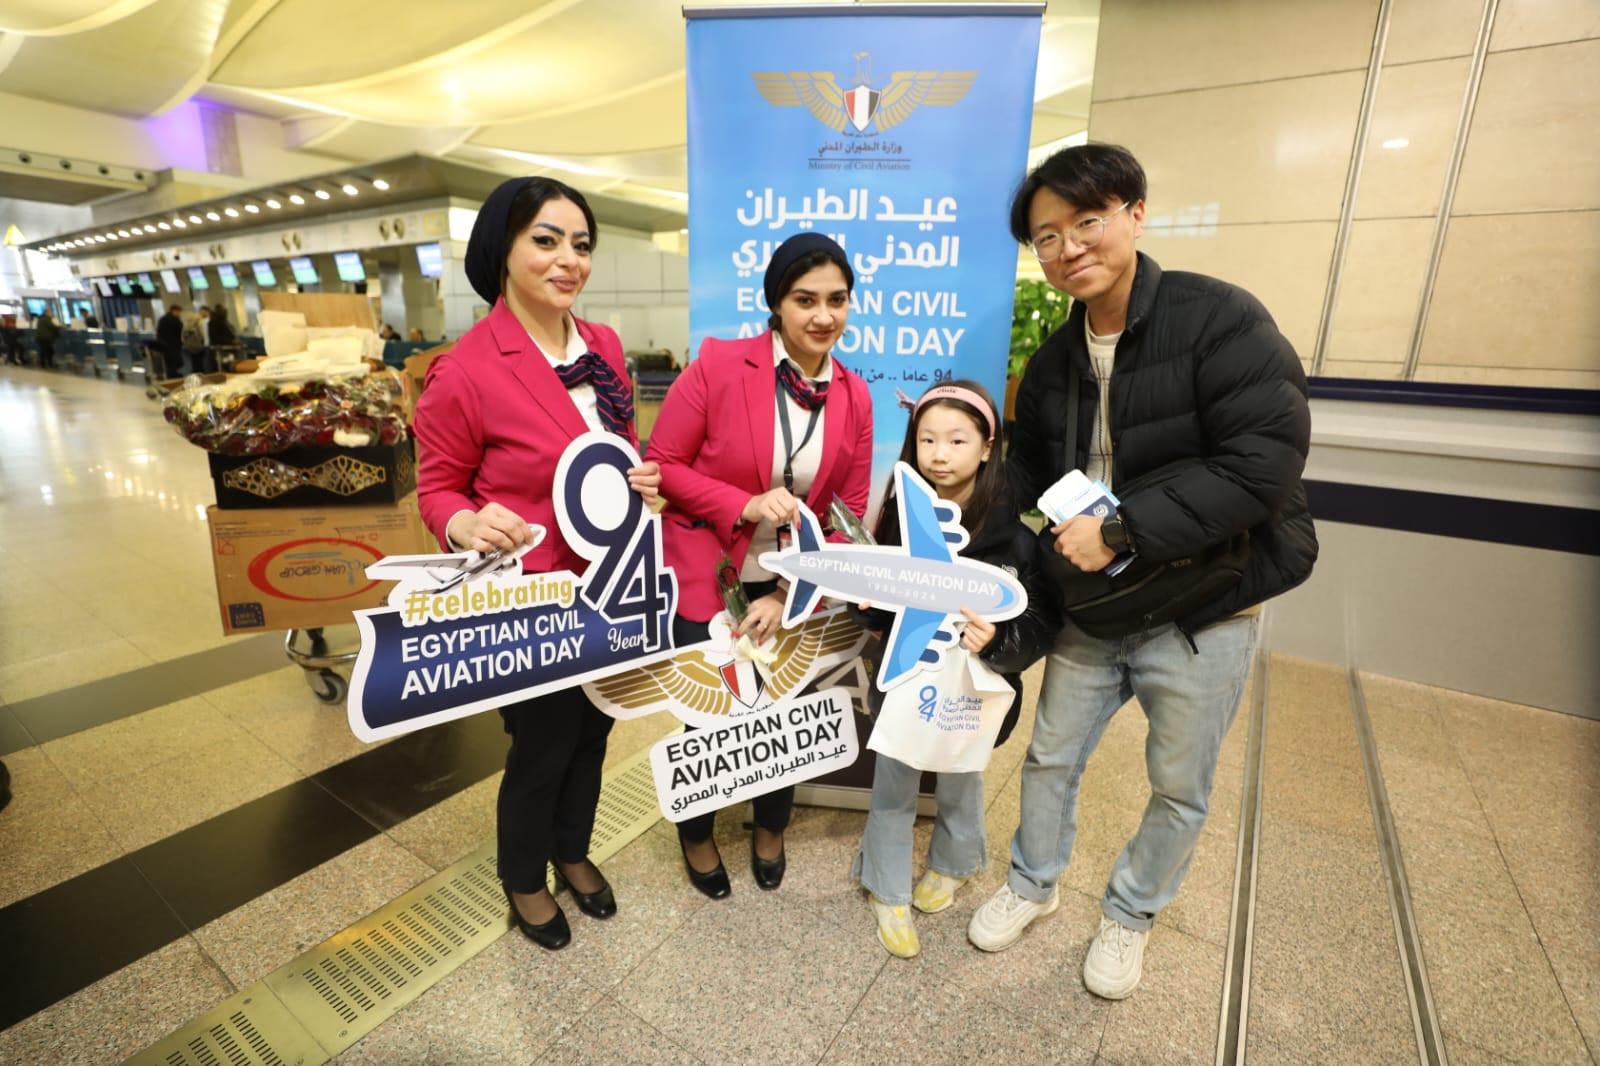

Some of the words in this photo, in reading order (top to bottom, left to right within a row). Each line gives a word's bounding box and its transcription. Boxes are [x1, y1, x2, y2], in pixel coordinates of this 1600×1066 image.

[808, 160, 841, 171] Ministry
[844, 160, 854, 171] of
[855, 160, 874, 171] Civil
[876, 161, 911, 171] Aviation
[853, 234, 960, 283] المدني
[892, 291, 967, 317] CIVIL
[896, 327, 965, 356] DAY
[564, 442, 667, 649] 94
[404, 576, 573, 622] #celebrating
[799, 555, 860, 575] EGYPTIAN
[863, 565, 894, 581] CIVIL
[898, 569, 964, 592] AVIATION
[968, 578, 999, 597] DAY
[401, 619, 529, 663] EGYPTIAN
[534, 609, 585, 636] CIVIL
[401, 645, 533, 700] AVIATION
[540, 634, 586, 667] DAY
[666, 713, 783, 764] EGYPTIAN
[788, 697, 842, 726] CIVIL
[671, 735, 789, 790] AVIATION
[795, 718, 843, 750] DAY
[671, 784, 718, 814] المصري
[722, 770, 763, 798] المدني
